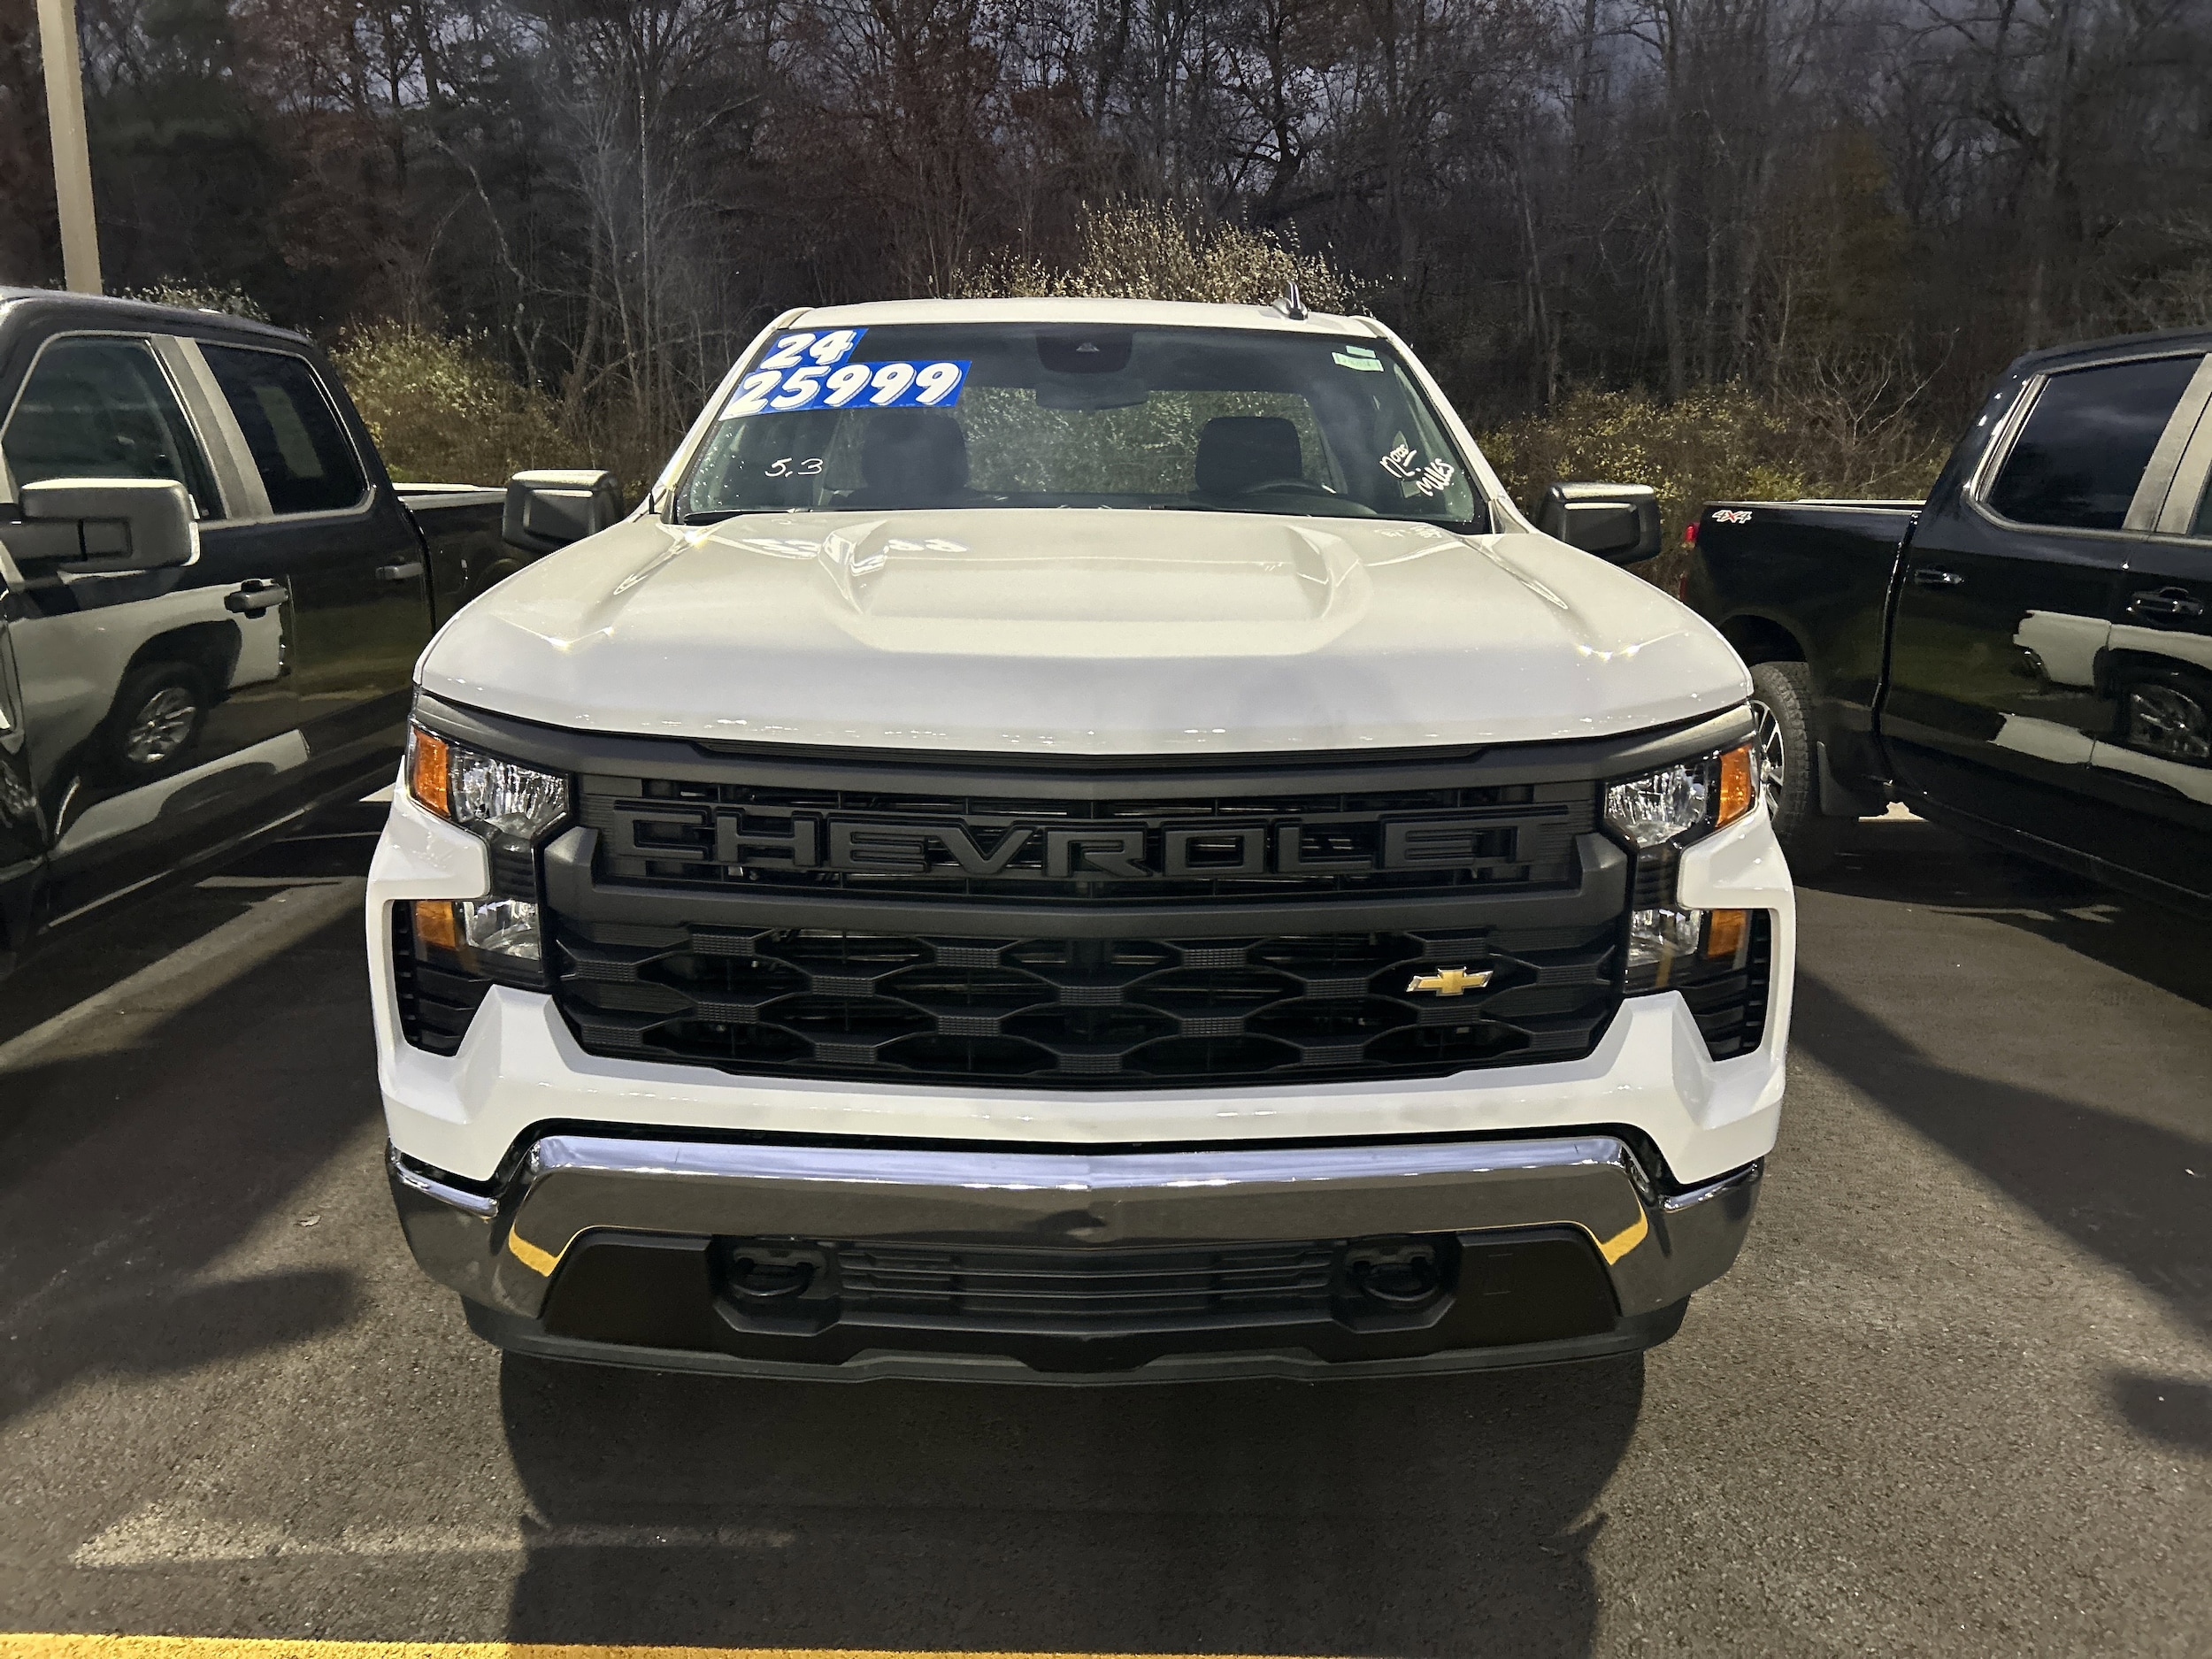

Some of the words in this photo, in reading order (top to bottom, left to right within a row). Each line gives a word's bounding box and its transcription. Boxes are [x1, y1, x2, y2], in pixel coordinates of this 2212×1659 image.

[760, 329, 856, 370] 24
[718, 362, 963, 420] 25999
[614, 800, 1566, 877] CHEVROLET
